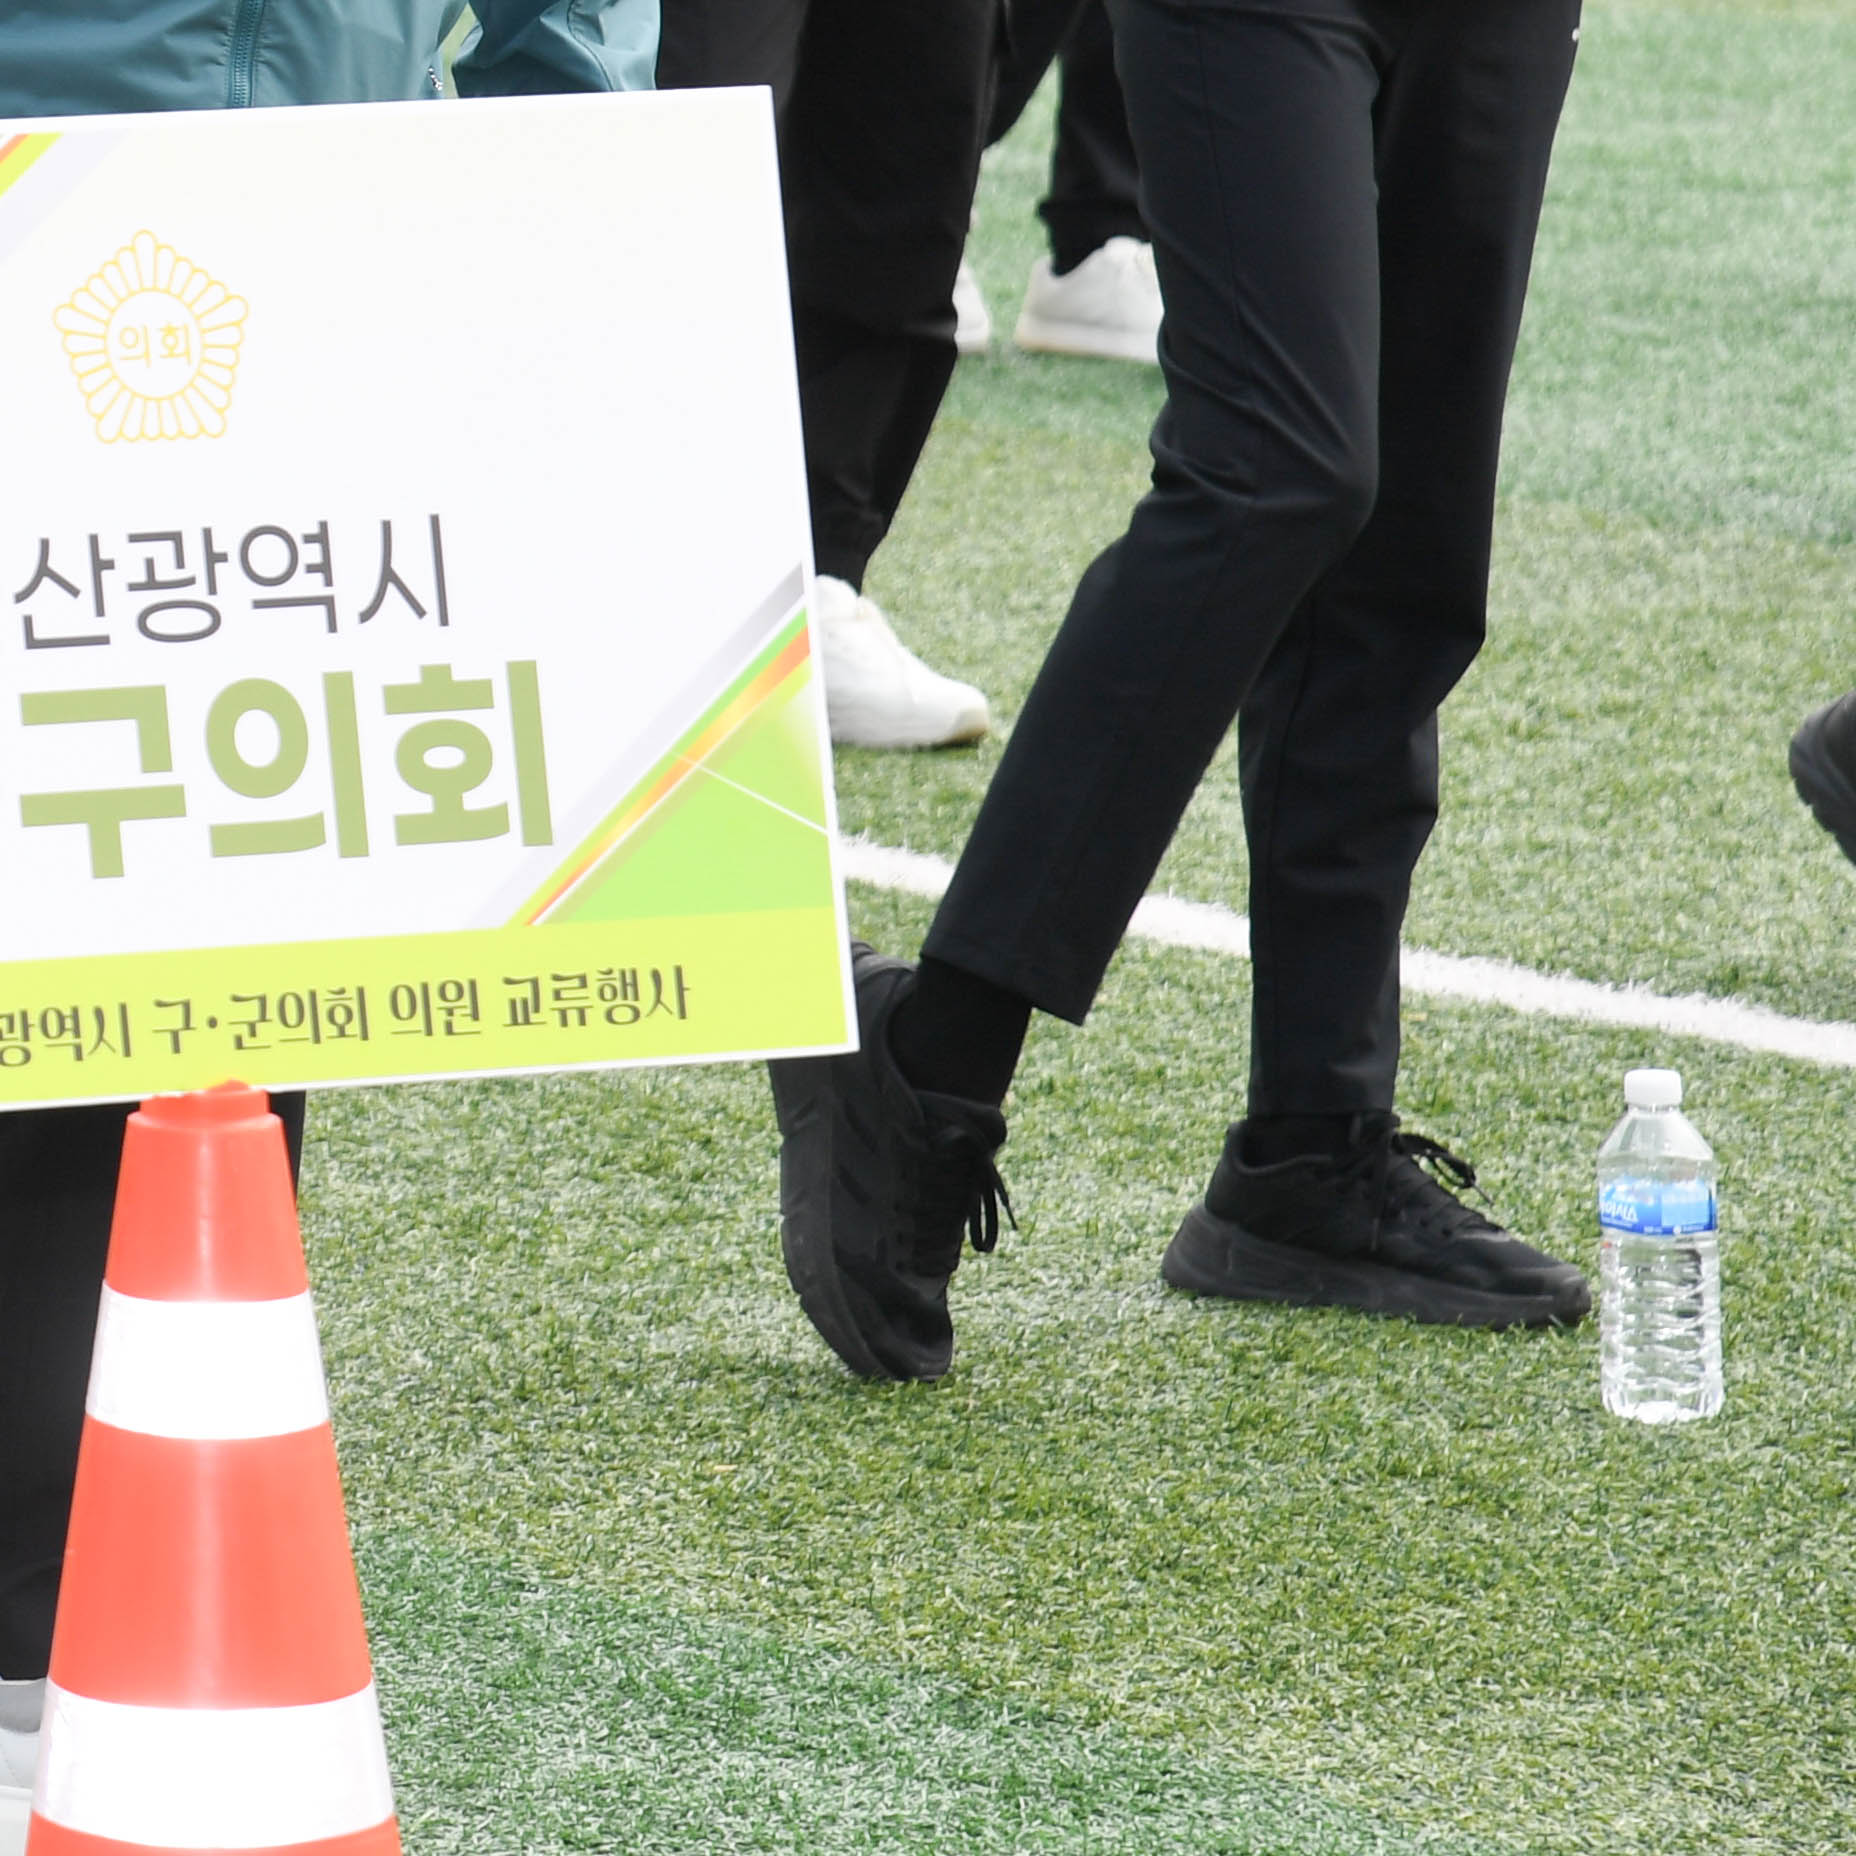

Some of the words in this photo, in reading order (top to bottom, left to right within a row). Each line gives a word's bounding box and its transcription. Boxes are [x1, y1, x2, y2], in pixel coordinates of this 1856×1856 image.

[118, 322, 192, 369] 의회
[389, 978, 481, 1036] 의원
[502, 965, 691, 1027] 교류행사
